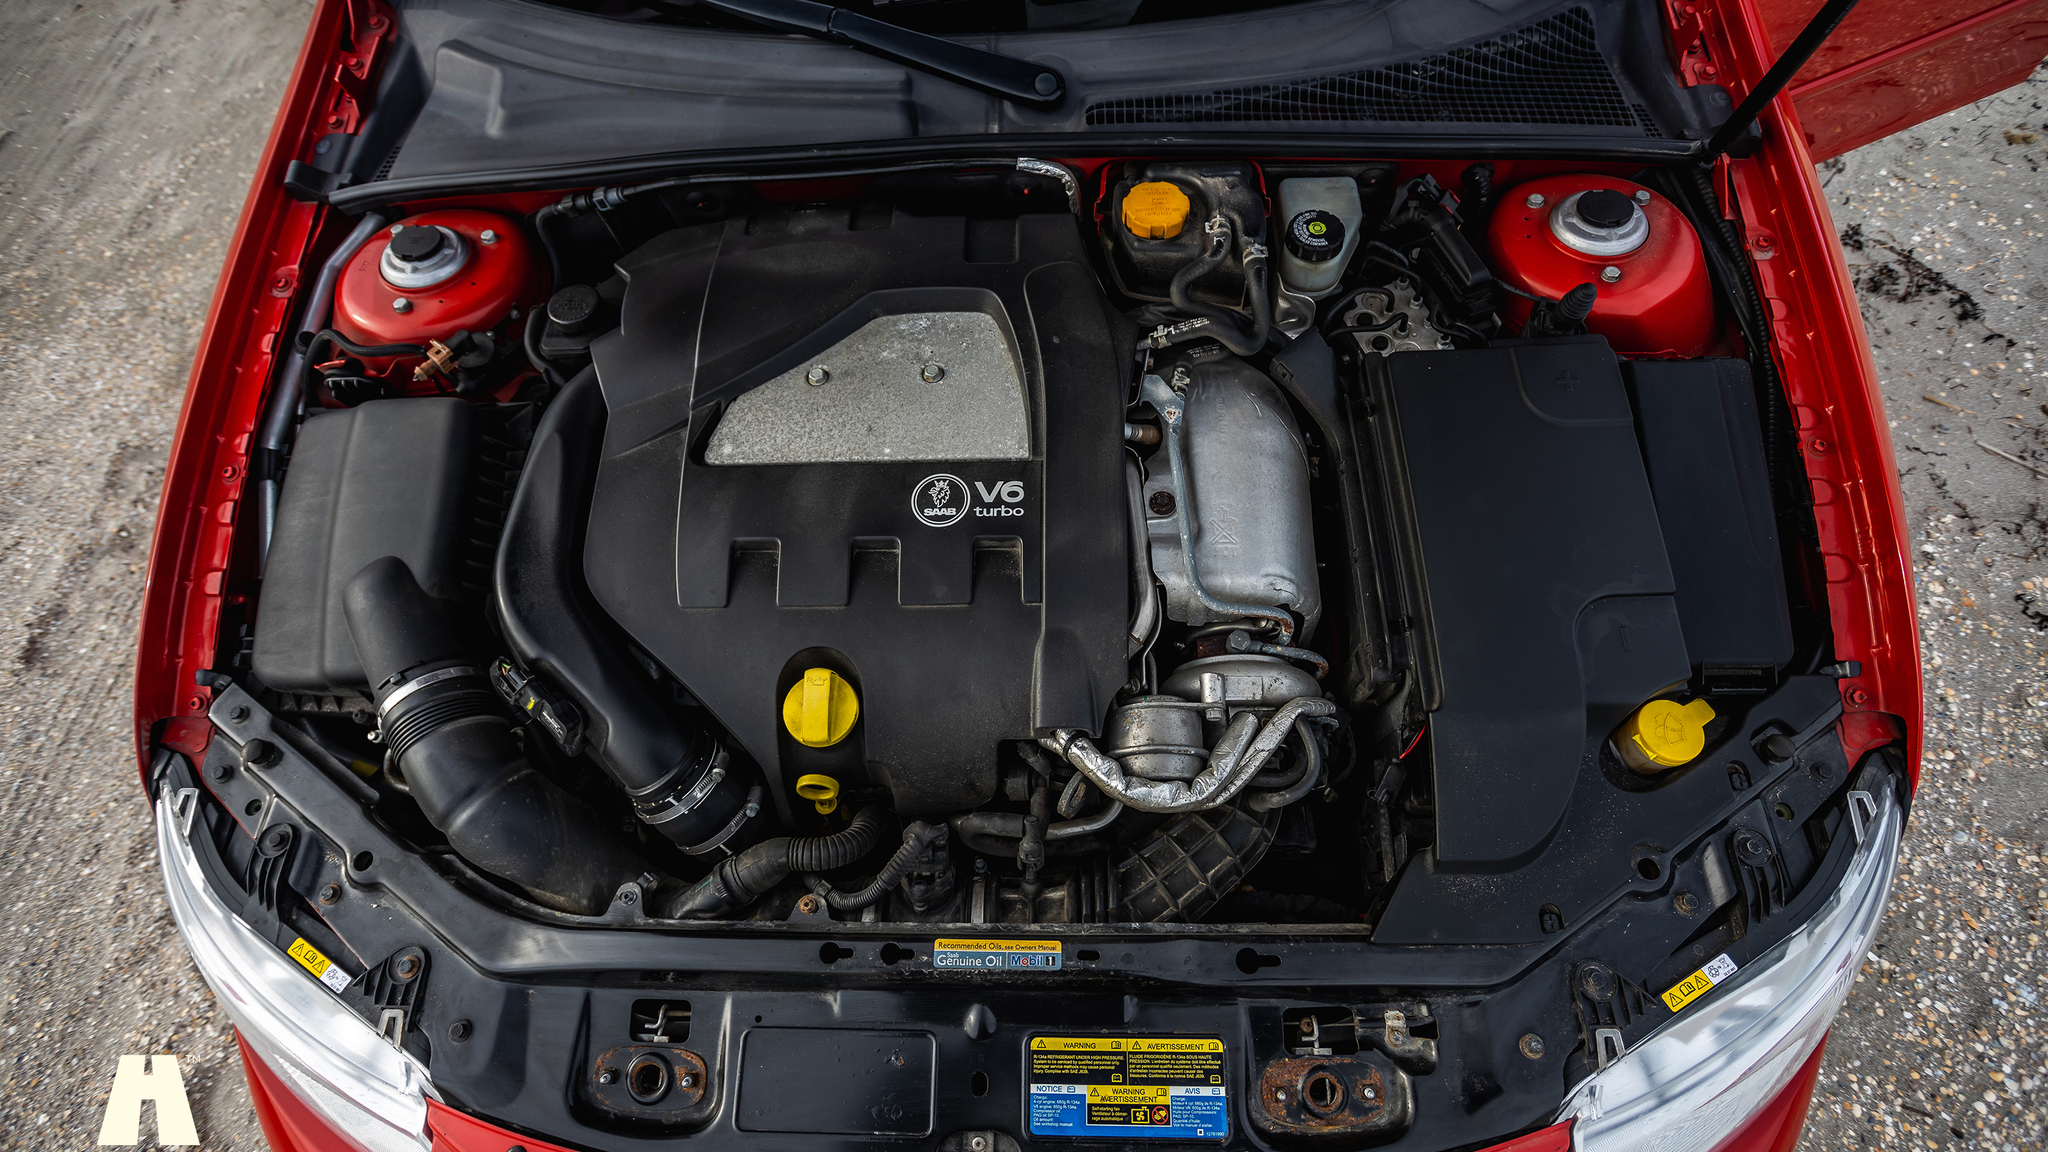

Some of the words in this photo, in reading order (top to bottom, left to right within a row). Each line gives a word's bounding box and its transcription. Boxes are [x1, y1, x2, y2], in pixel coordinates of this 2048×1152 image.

[974, 481, 1024, 503] V6
[924, 508, 956, 516] SAAB
[974, 505, 1024, 517] turbo
[938, 942, 986, 950] Recommended
[988, 943, 1003, 951] Oils,
[937, 954, 982, 966] Genuine
[985, 955, 1002, 967] Oil
[1011, 955, 1043, 966] Mobil
